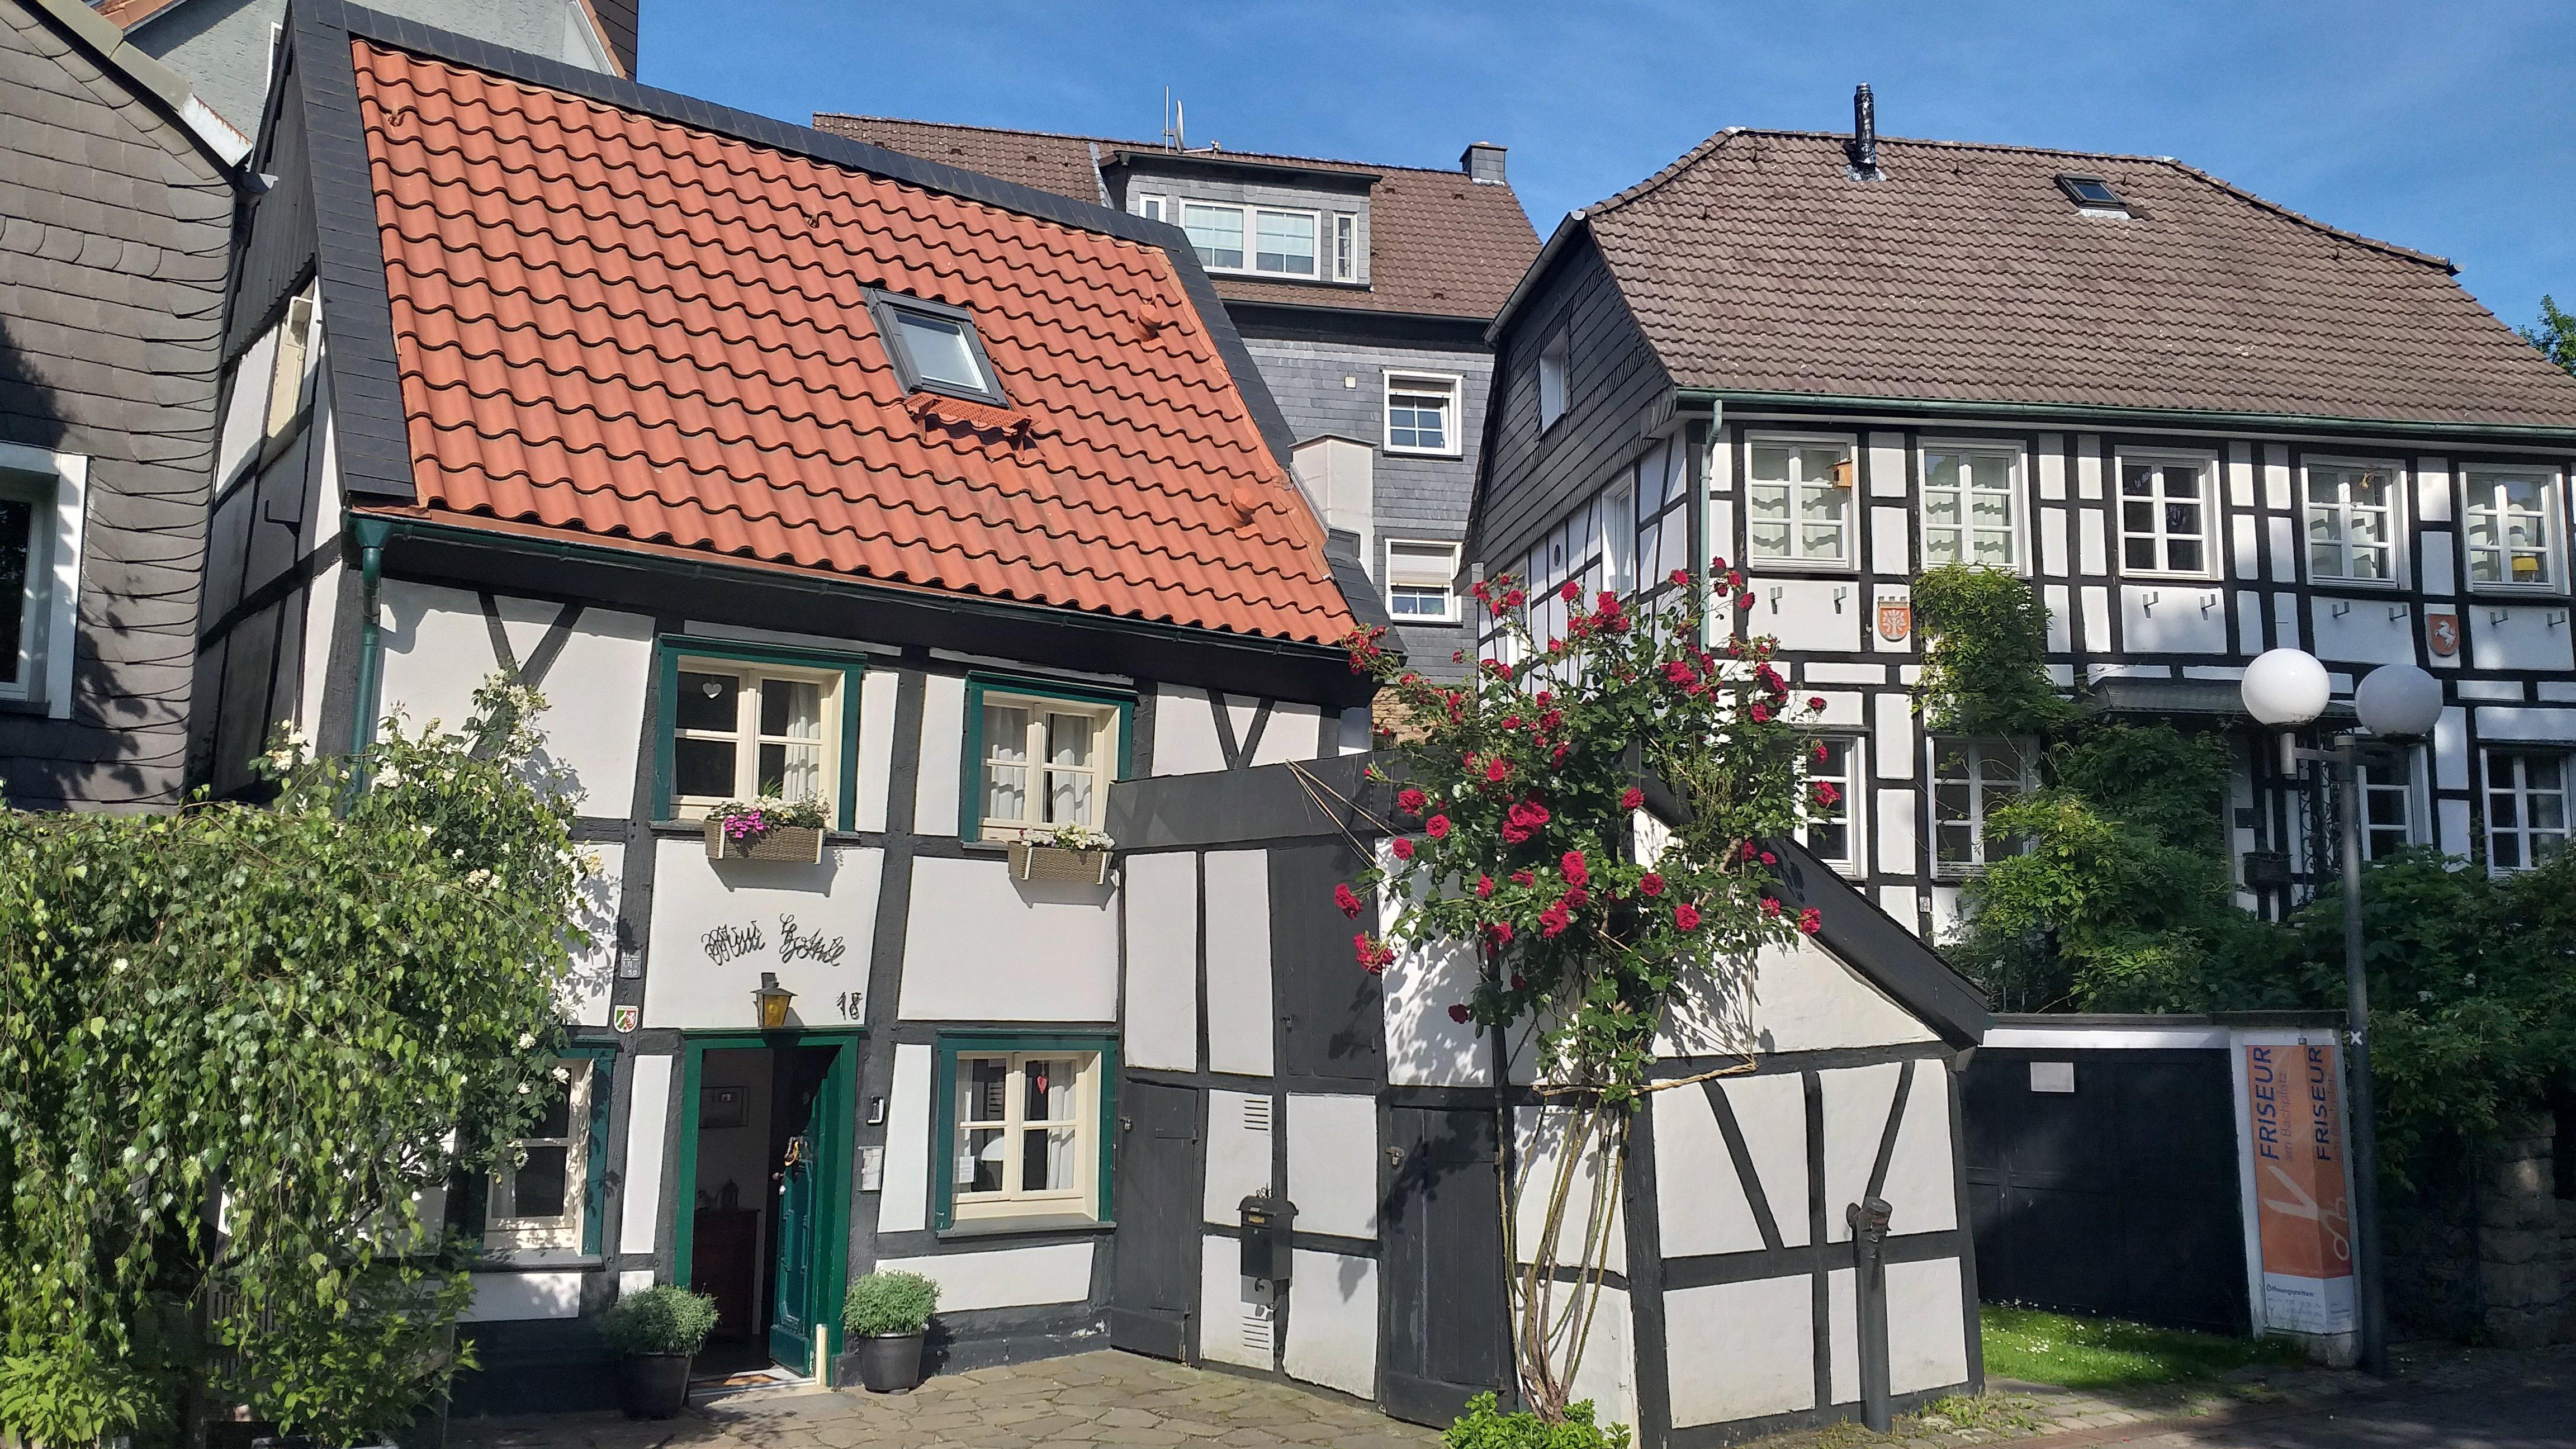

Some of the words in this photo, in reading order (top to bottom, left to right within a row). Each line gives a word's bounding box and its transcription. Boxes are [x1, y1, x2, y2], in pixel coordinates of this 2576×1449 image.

[835, 991, 863, 1021] 18
[2253, 1046, 2280, 1161] FRISEUR
[2277, 1072, 2291, 1137] Bachplatz
[2308, 1046, 2331, 1161] FRISEUR
